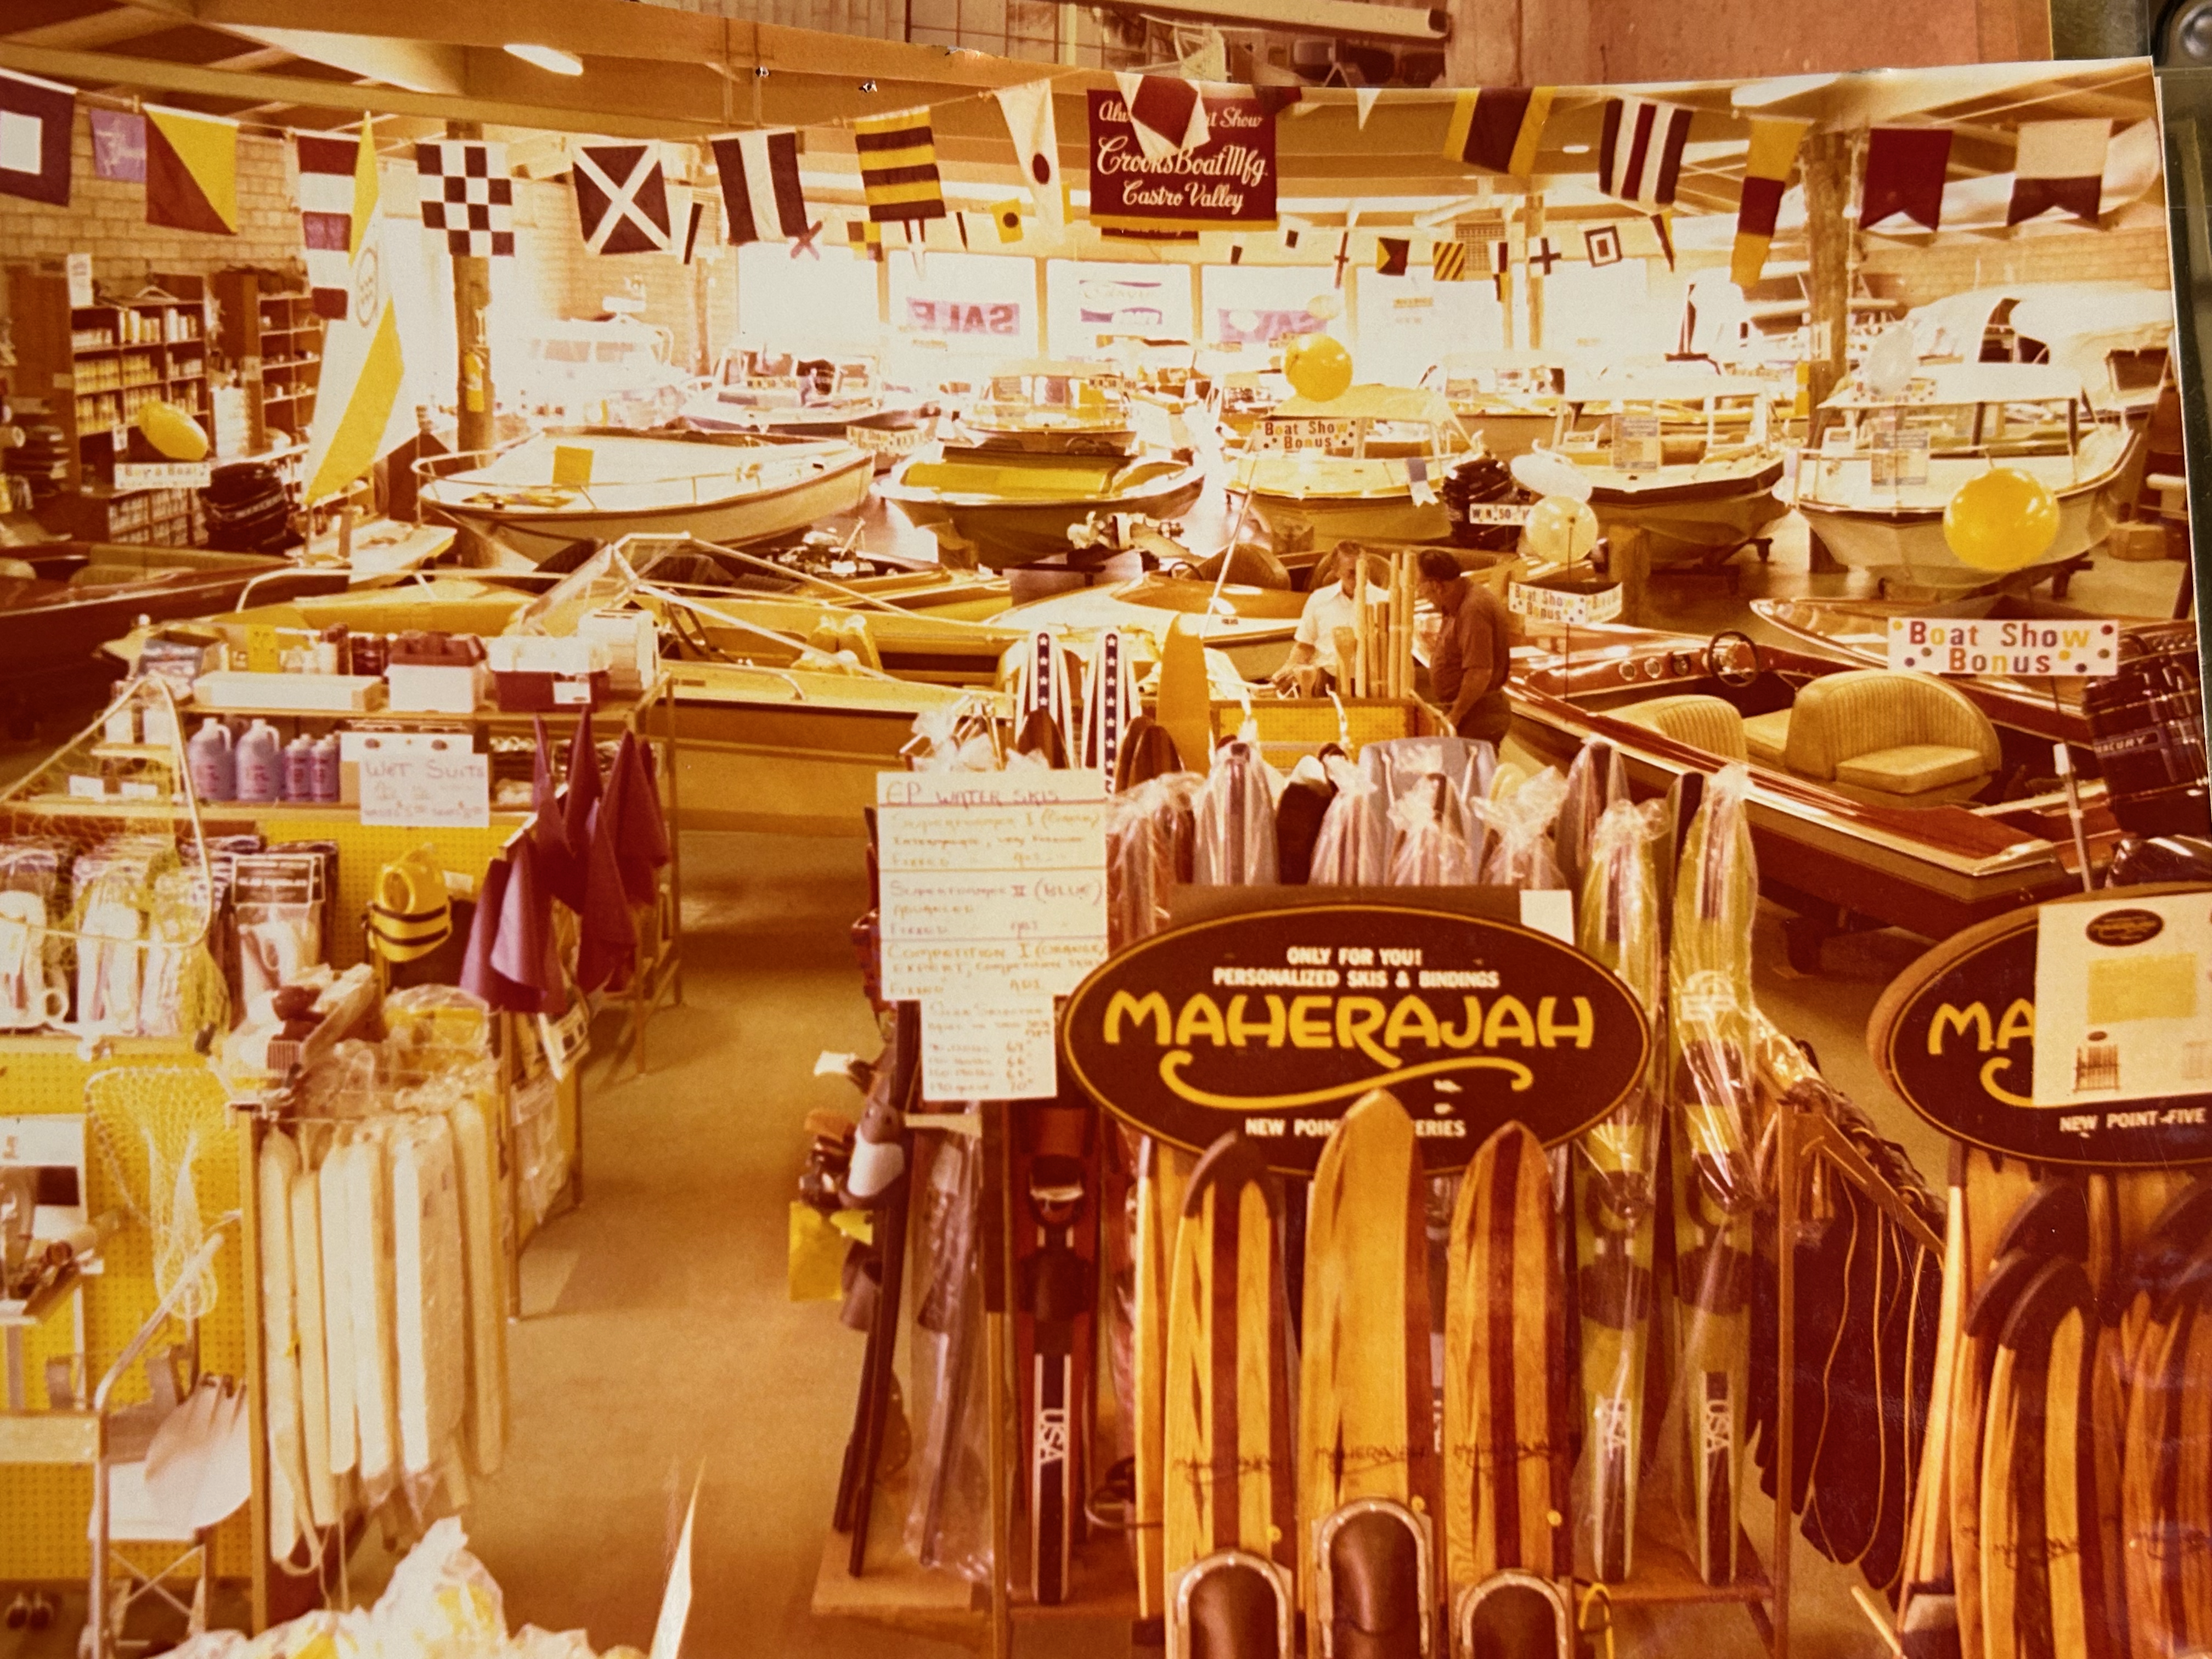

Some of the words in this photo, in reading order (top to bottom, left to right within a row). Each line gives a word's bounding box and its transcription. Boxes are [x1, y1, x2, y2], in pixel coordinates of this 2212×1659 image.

[1220, 106, 1263, 128] Show
[1175, 149, 1227, 174] Boat
[1122, 179, 1183, 206] Castro
[1184, 182, 1244, 215] Valley
[1265, 421, 1299, 436] Boat
[1308, 420, 1348, 435] Show
[1284, 436, 1332, 449] Bonus
[1909, 621, 1978, 645] Boat
[2001, 623, 2091, 648] Show
[1949, 648, 2051, 674] Bonus
[1286, 946, 1331, 965] ONLY
[1338, 947, 1374, 966] FOR
[1379, 948, 1423, 966] YOU!
[1213, 967, 1340, 987] PERSONALIZED
[1347, 970, 1389, 988] SKIS
[1395, 970, 1410, 988] &
[1419, 970, 1500, 988] BINDINGS
[1103, 990, 1595, 1068] MAHERAJAH
[1245, 1118, 1285, 1137] NEW
[1293, 1119, 1340, 1137] POIN
[1415, 1119, 1466, 1138] ERIES
[2059, 1114, 2098, 1132] NEW
